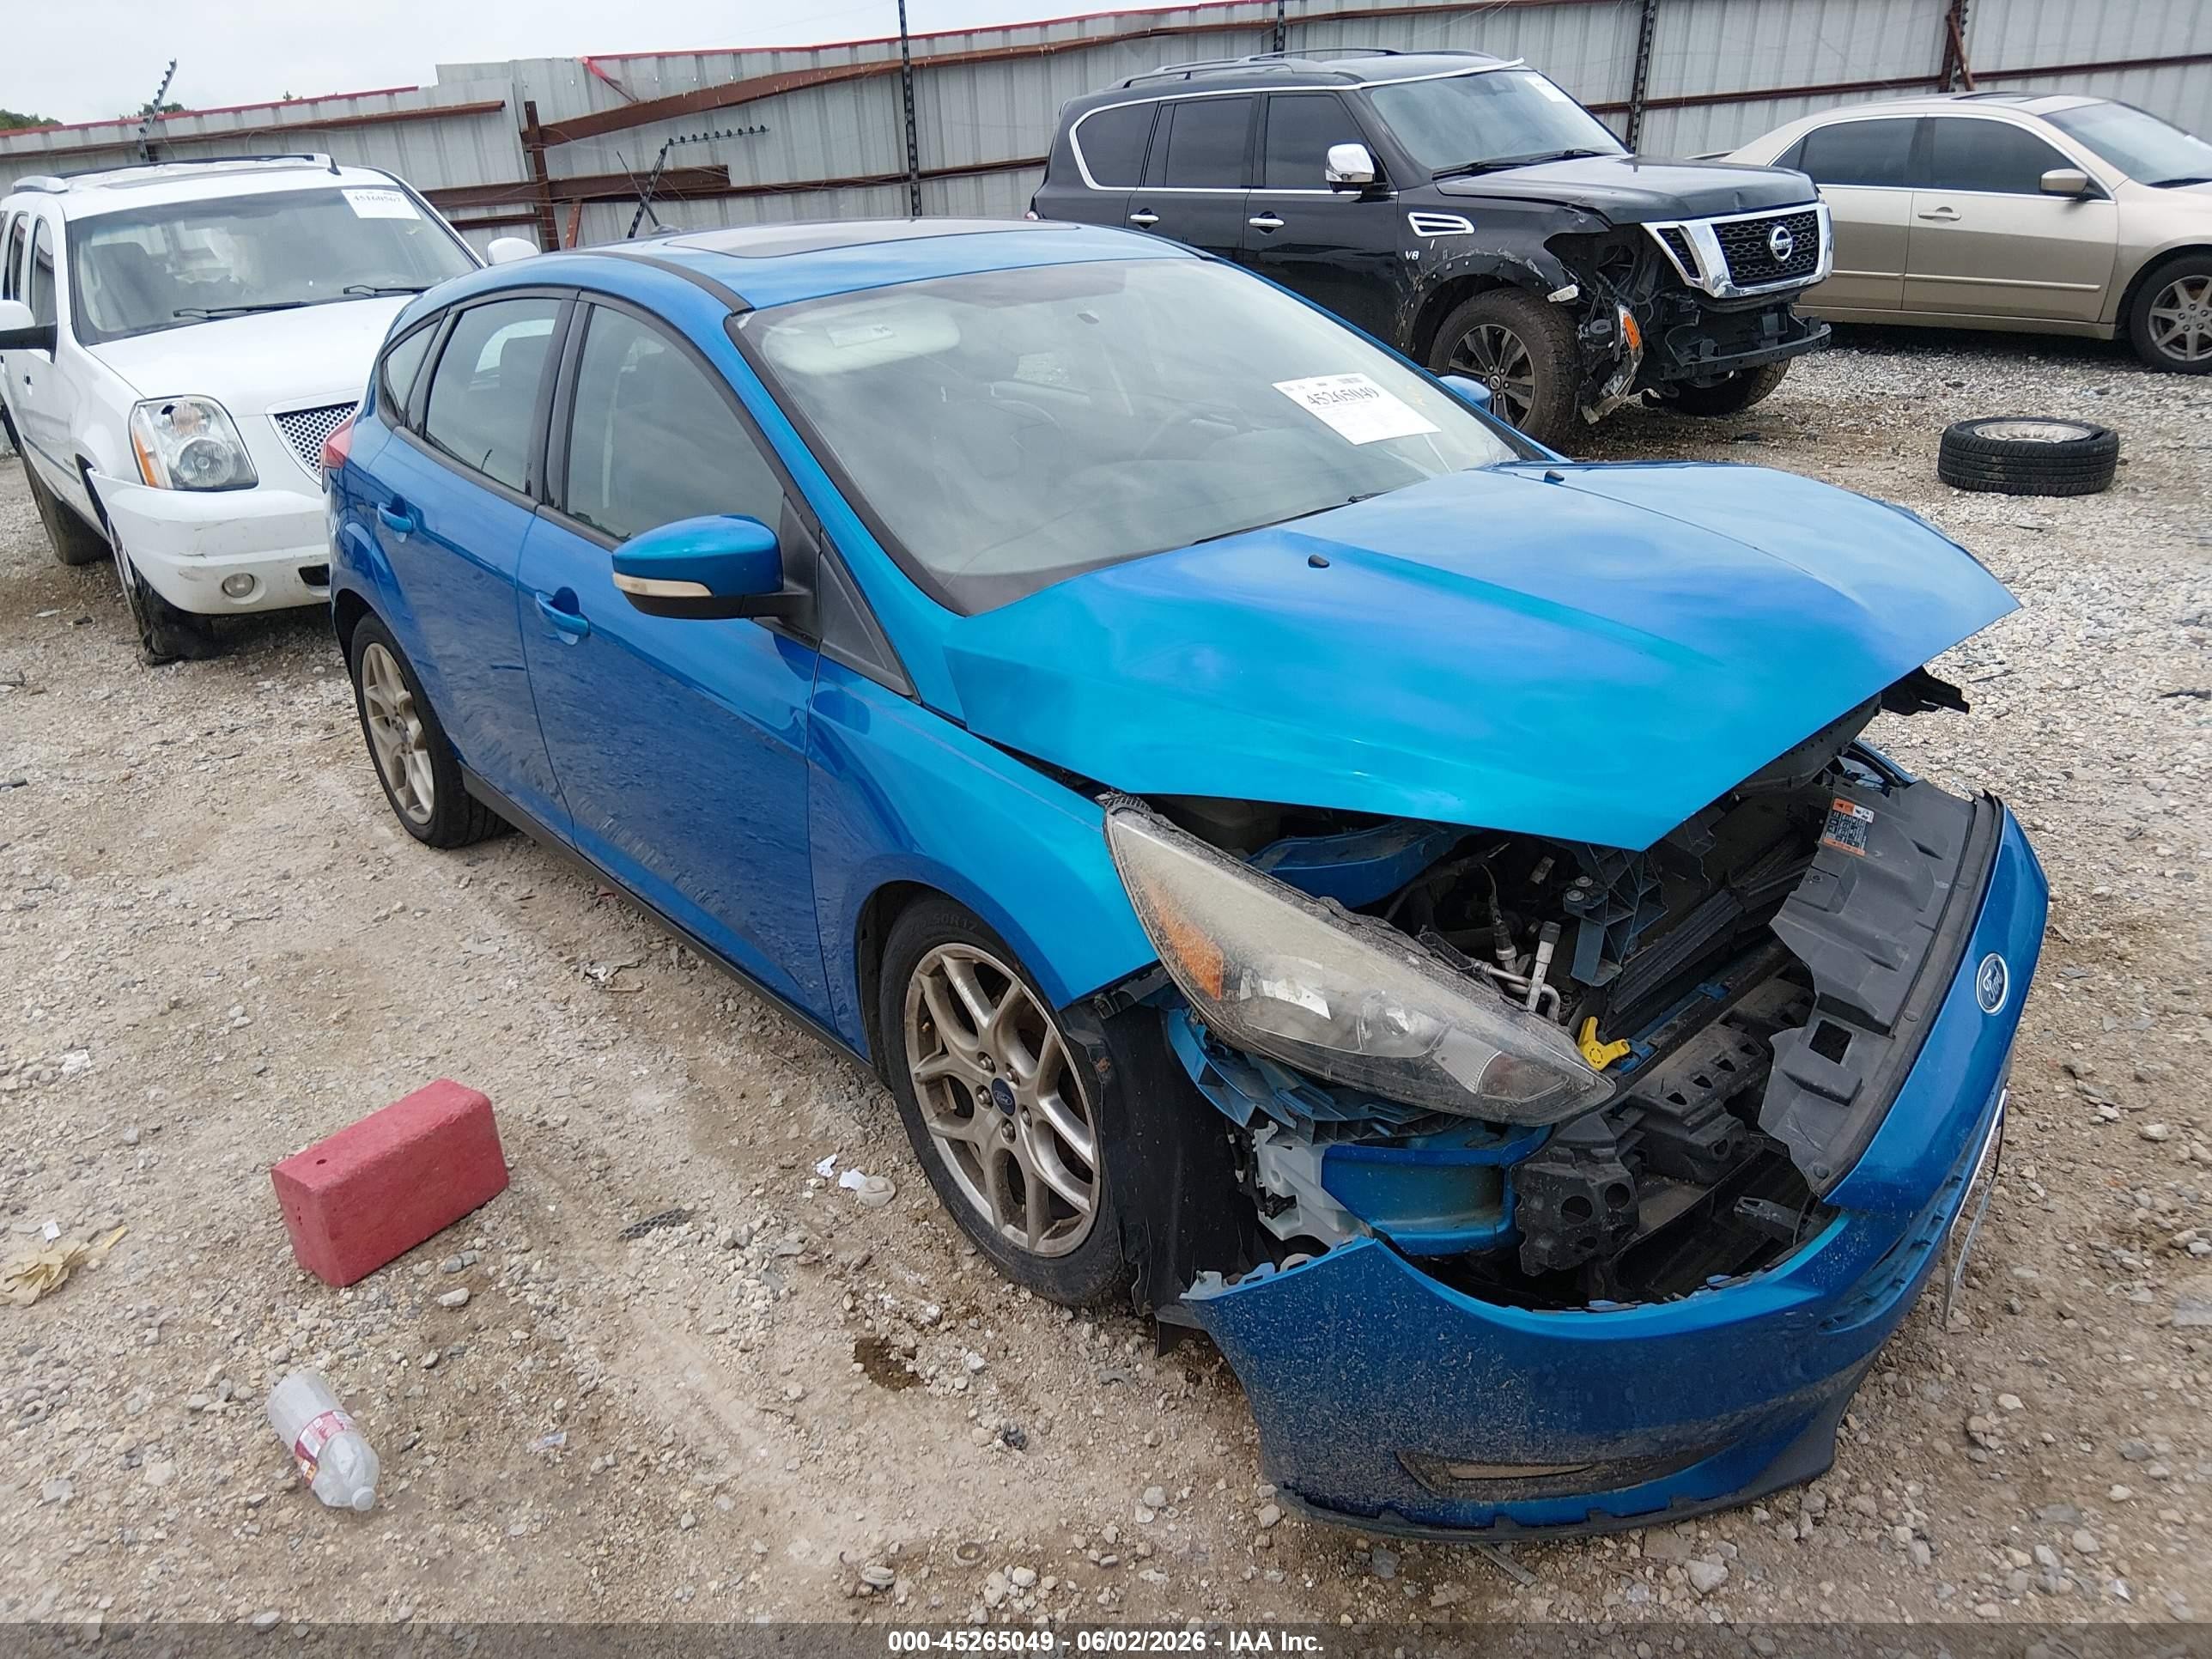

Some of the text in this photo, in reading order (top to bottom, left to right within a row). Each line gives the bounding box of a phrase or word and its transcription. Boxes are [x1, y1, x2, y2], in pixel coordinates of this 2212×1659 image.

[1405, 250, 1420, 260] V8
[1306, 386, 1380, 406] 45265049
[1983, 963, 2002, 1003] Ford
